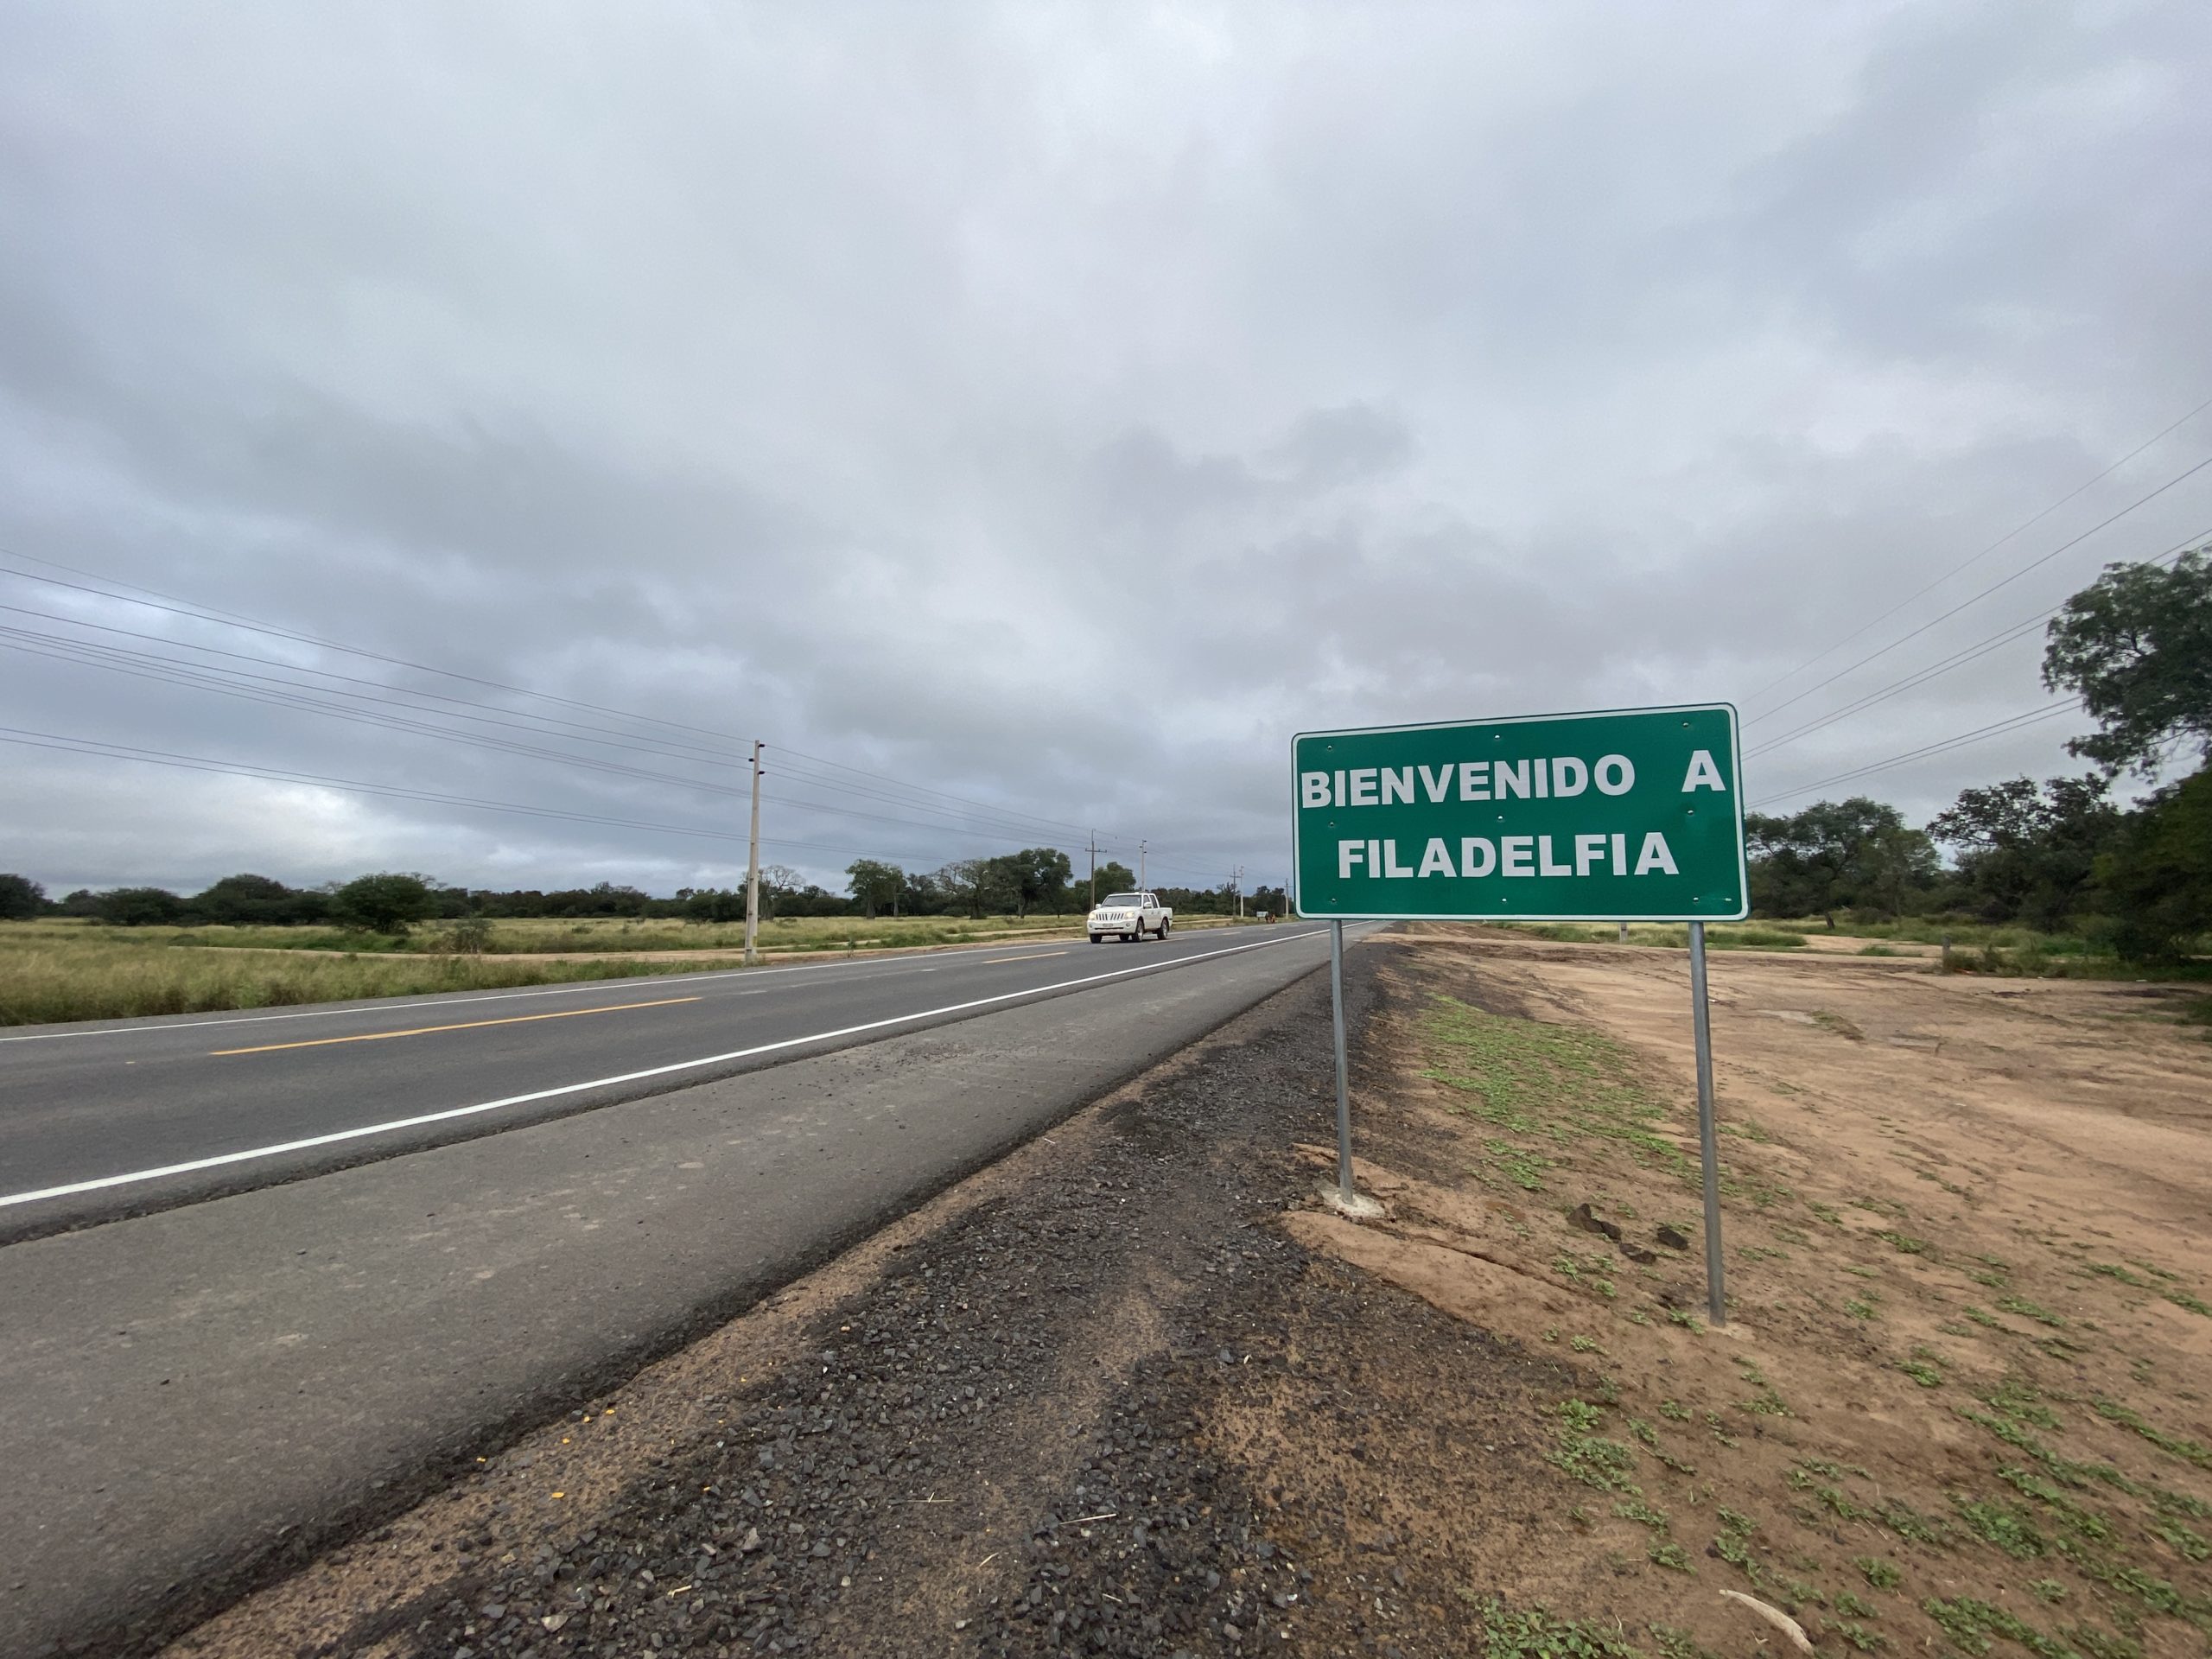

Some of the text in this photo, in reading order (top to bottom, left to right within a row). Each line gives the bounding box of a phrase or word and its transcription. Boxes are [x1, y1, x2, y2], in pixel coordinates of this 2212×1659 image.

[1301, 750, 1726, 809] BIENVENIDO A
[1338, 832, 1679, 878] FILADELFIA
